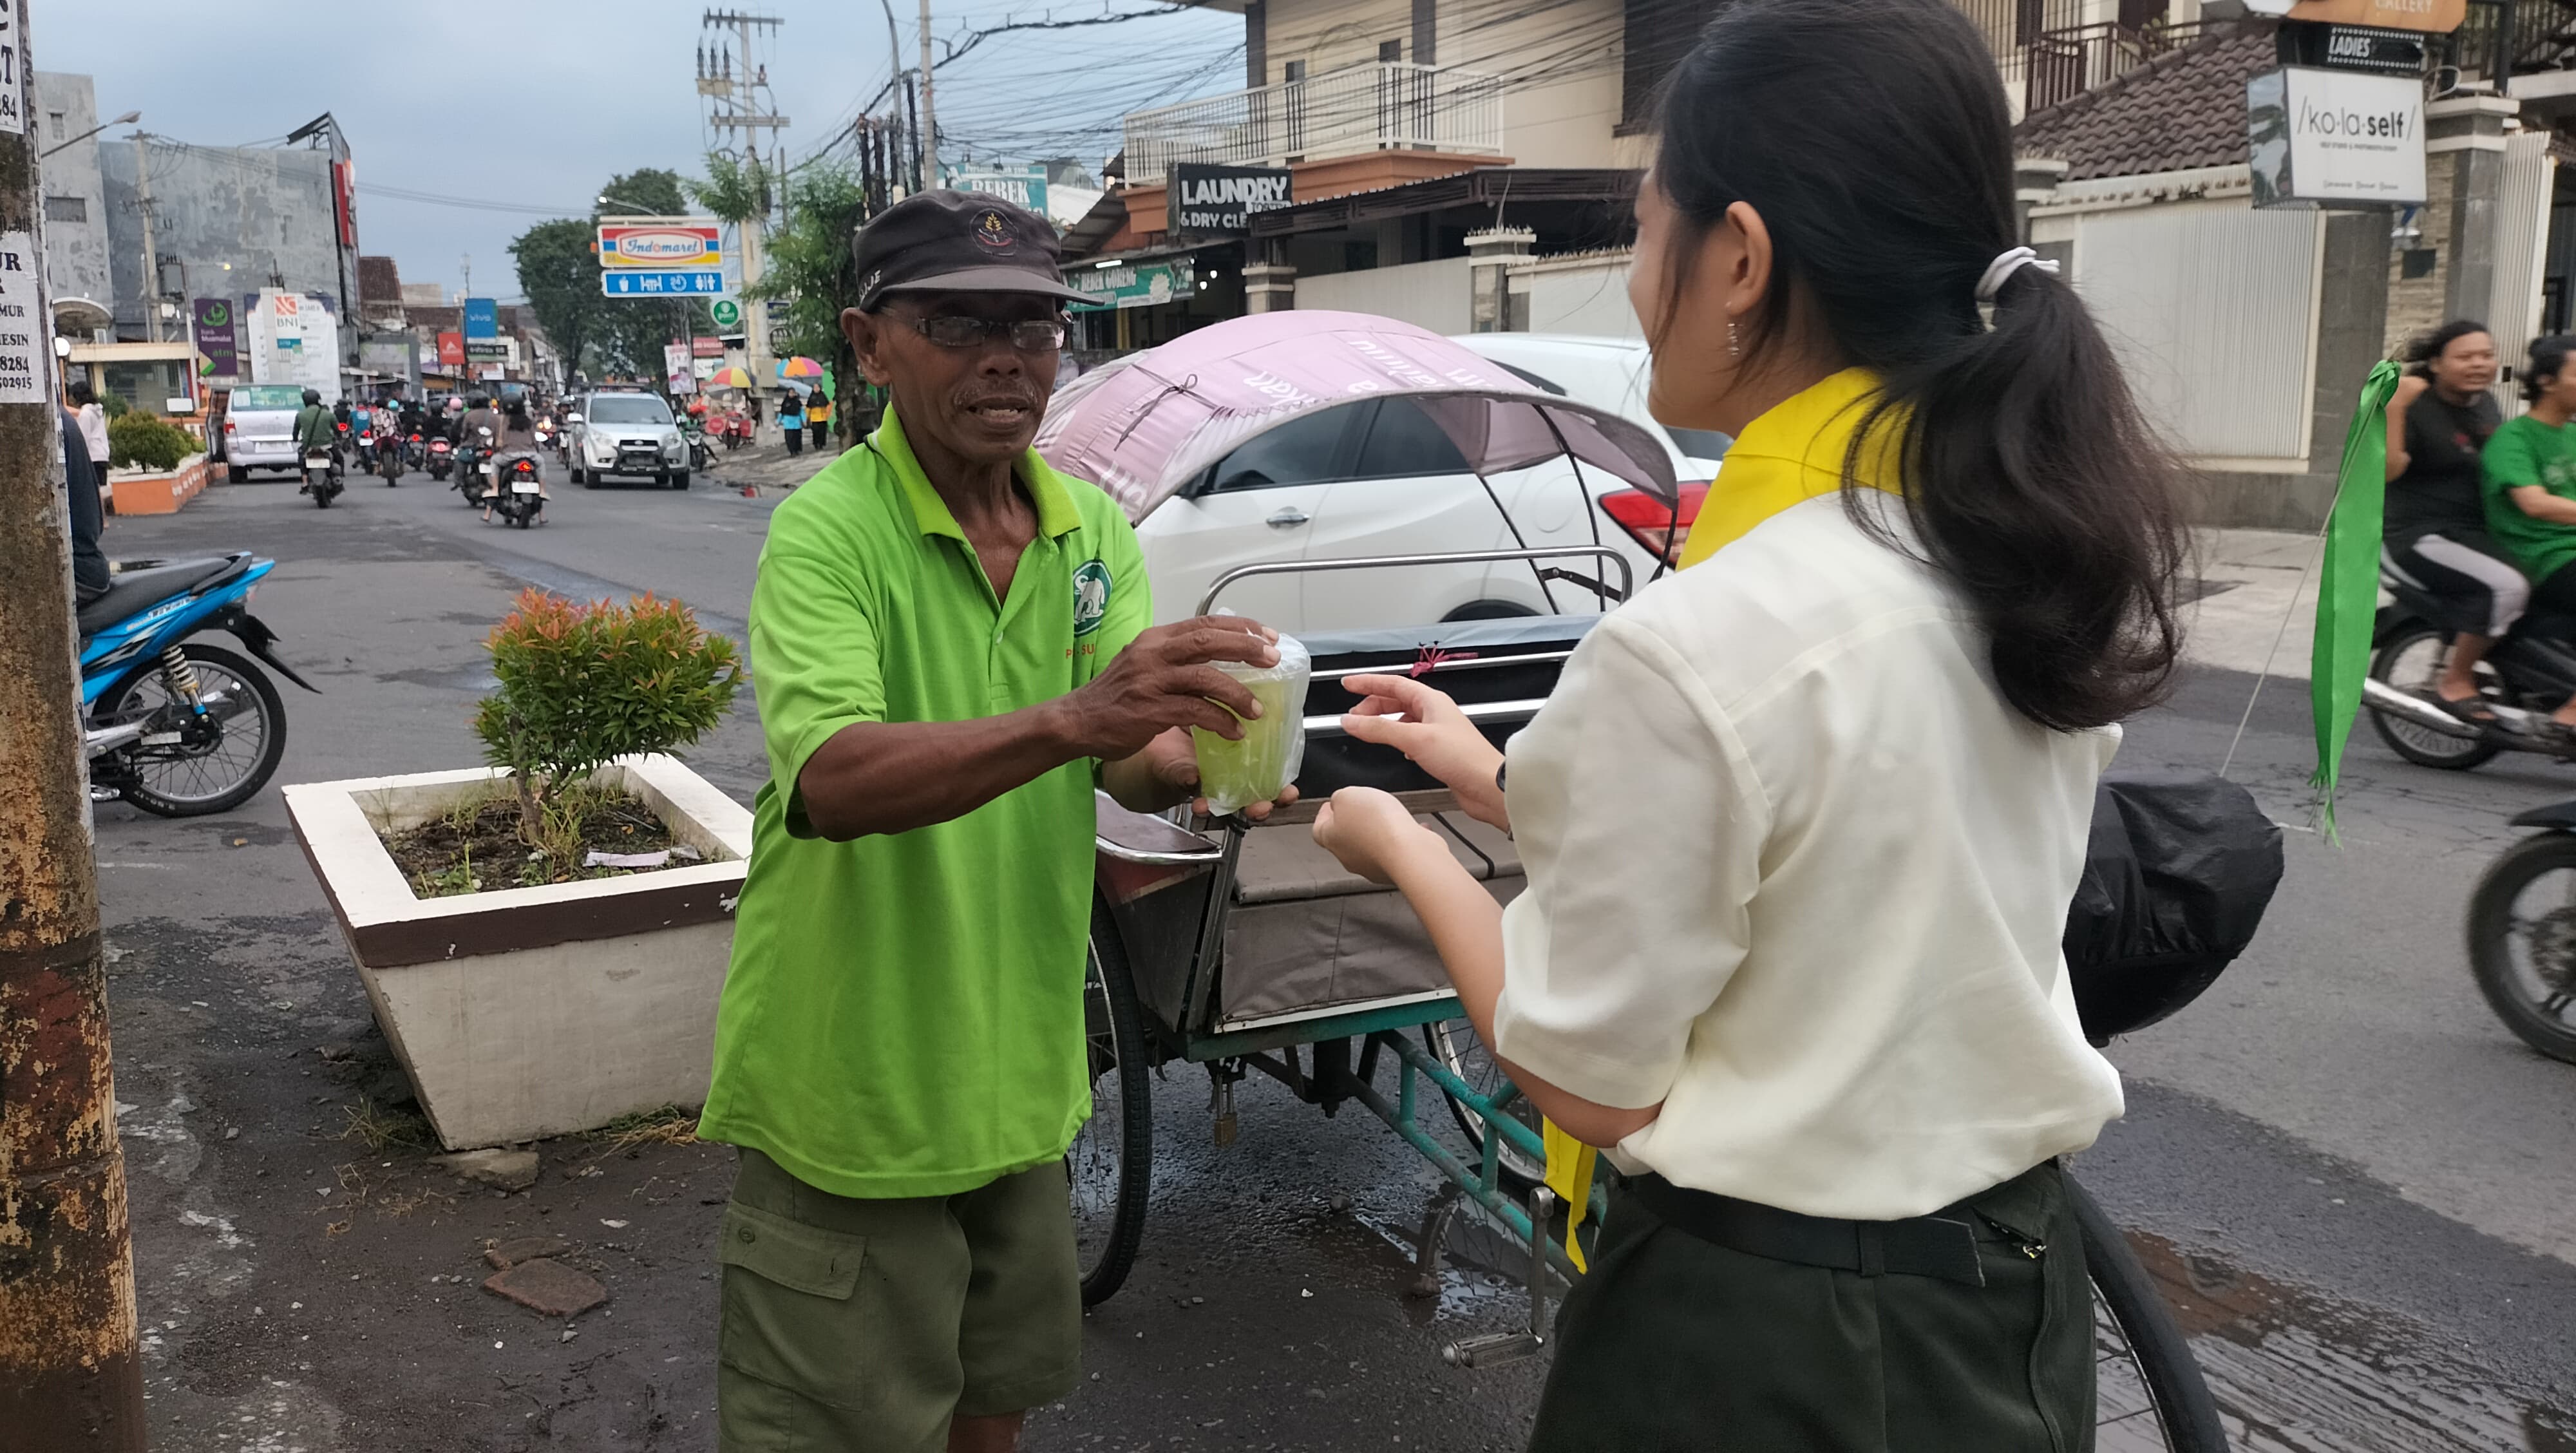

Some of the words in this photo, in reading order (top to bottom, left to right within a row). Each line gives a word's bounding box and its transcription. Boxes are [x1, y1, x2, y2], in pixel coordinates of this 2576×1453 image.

[2328, 35, 2371, 57] LADIES
[0, 44, 14, 84] T
[0, 93, 17, 121] 84
[1181, 176, 1287, 205] LAUNDRY
[1180, 211, 1189, 226] &
[1191, 212, 1220, 227] DRY
[625, 239, 697, 253] Indomaret
[277, 318, 298, 327] BNI
[0, 333, 29, 347] ESIN
